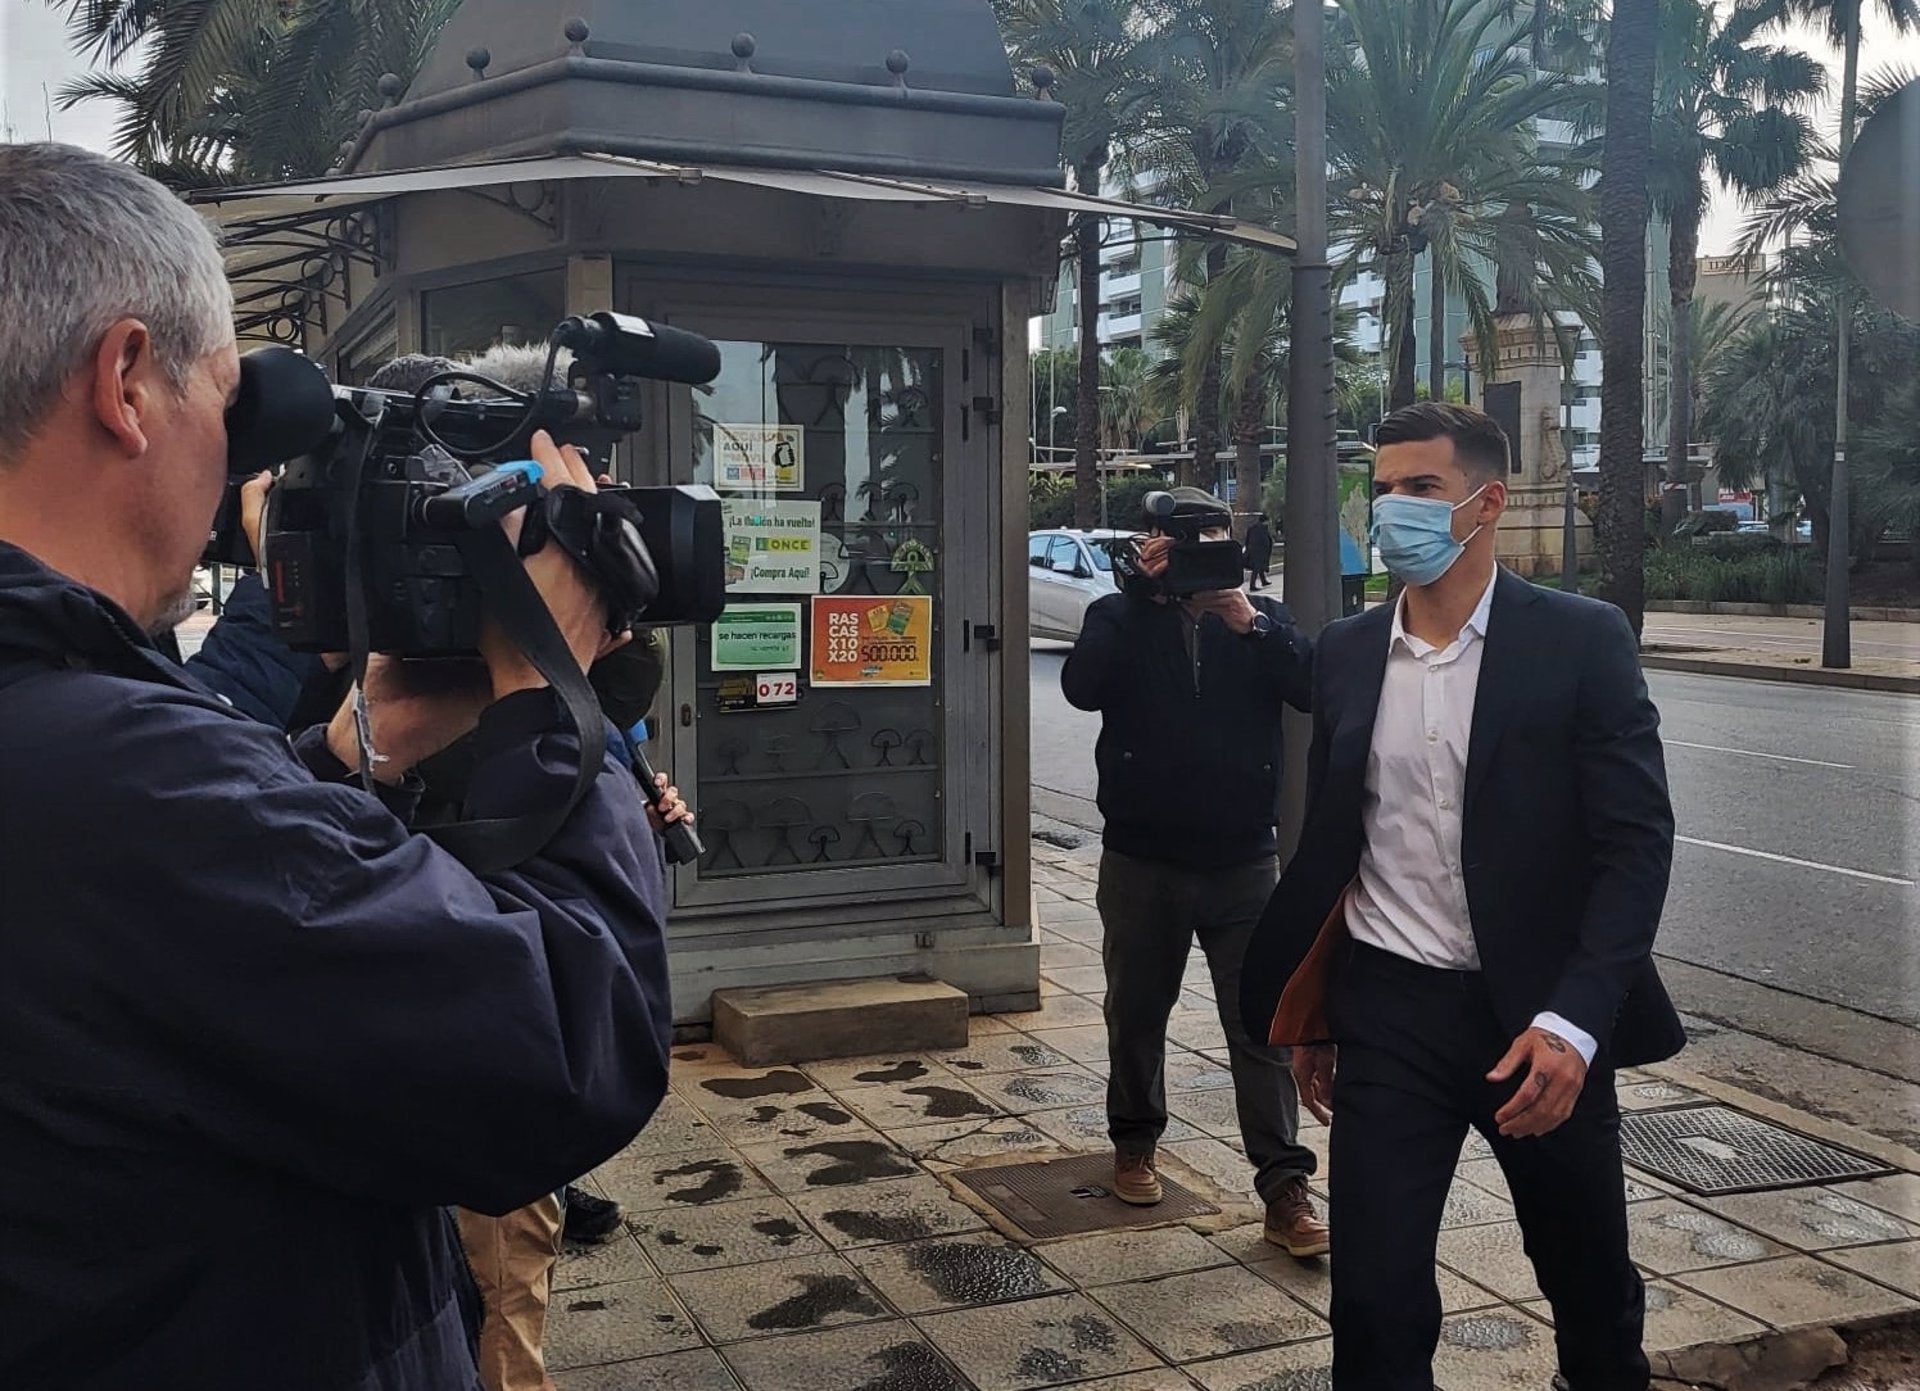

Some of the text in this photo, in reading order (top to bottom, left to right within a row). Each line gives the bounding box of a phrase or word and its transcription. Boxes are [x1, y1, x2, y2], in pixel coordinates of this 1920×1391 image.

[774, 516, 785, 527] ha
[771, 540, 809, 550] ONCE
[828, 613, 859, 625] RAS
[731, 630, 758, 640] hacen
[759, 632, 797, 642] recargas
[828, 625, 859, 637] CAS
[828, 638, 858, 650] X10
[828, 650, 858, 663] X20
